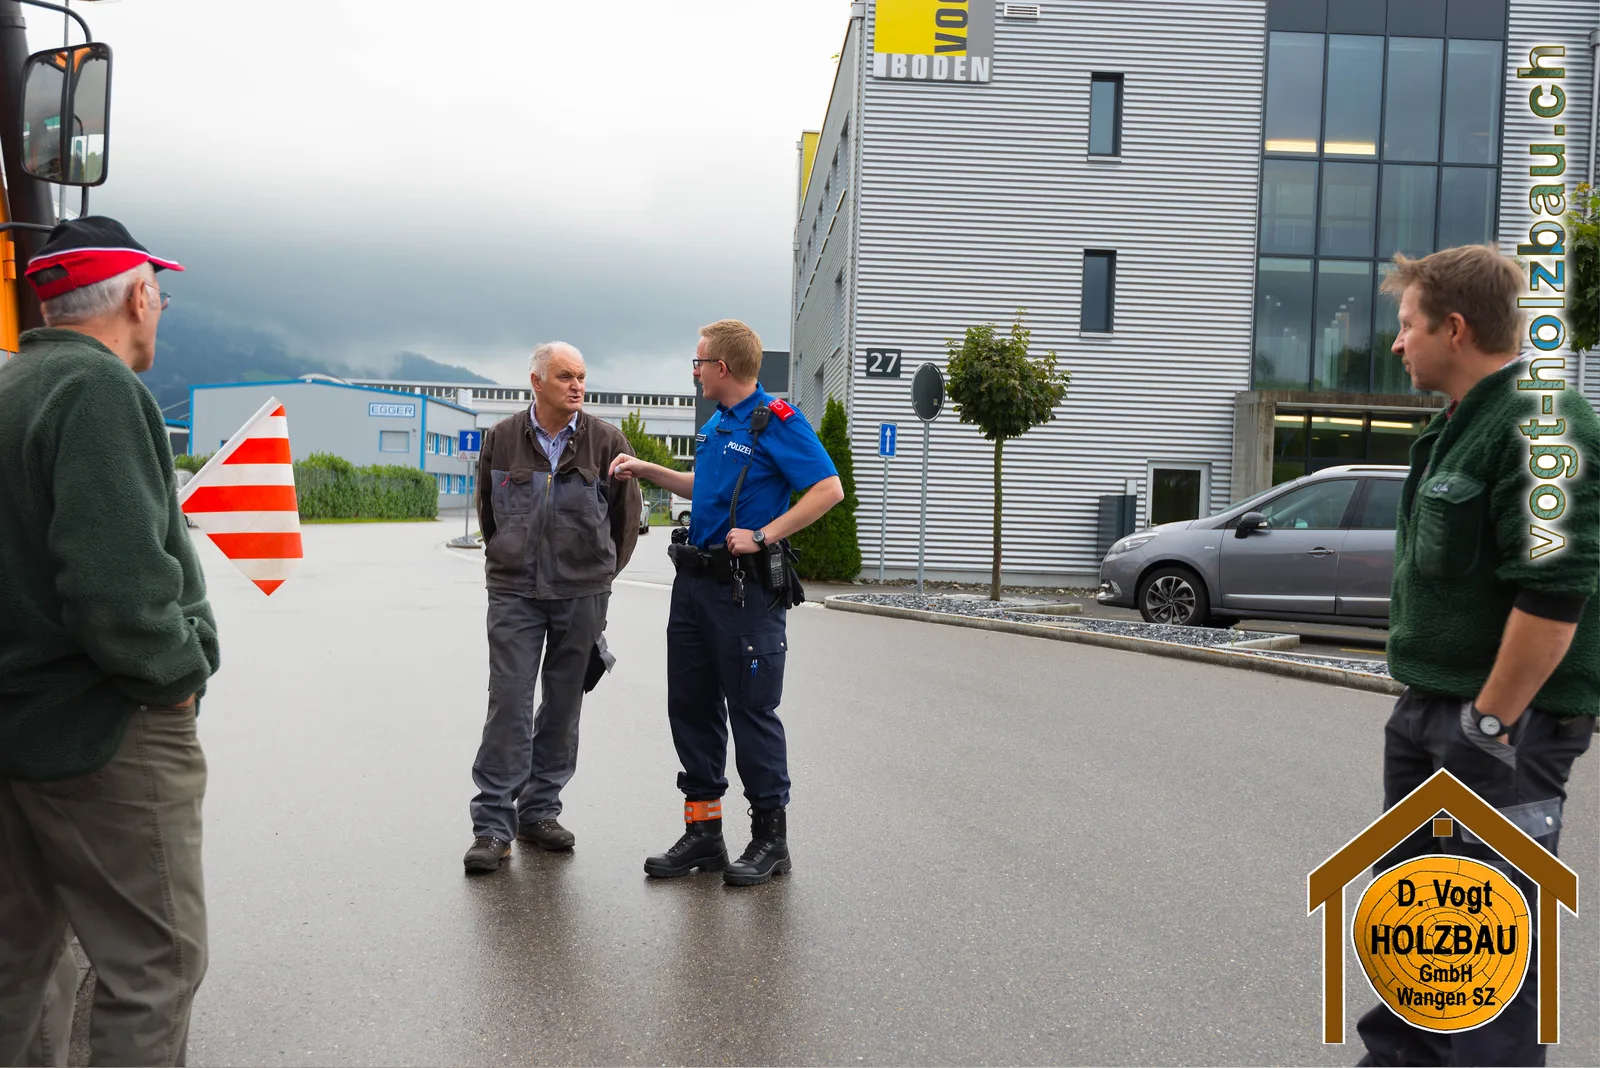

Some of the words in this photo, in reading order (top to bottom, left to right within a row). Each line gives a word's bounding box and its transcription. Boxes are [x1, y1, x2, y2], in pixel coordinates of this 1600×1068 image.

[934, 0, 968, 53] VO
[891, 53, 989, 82] BODEN
[869, 352, 898, 373] 27
[371, 405, 413, 415] EGGER
[728, 441, 751, 455] POLIZEI
